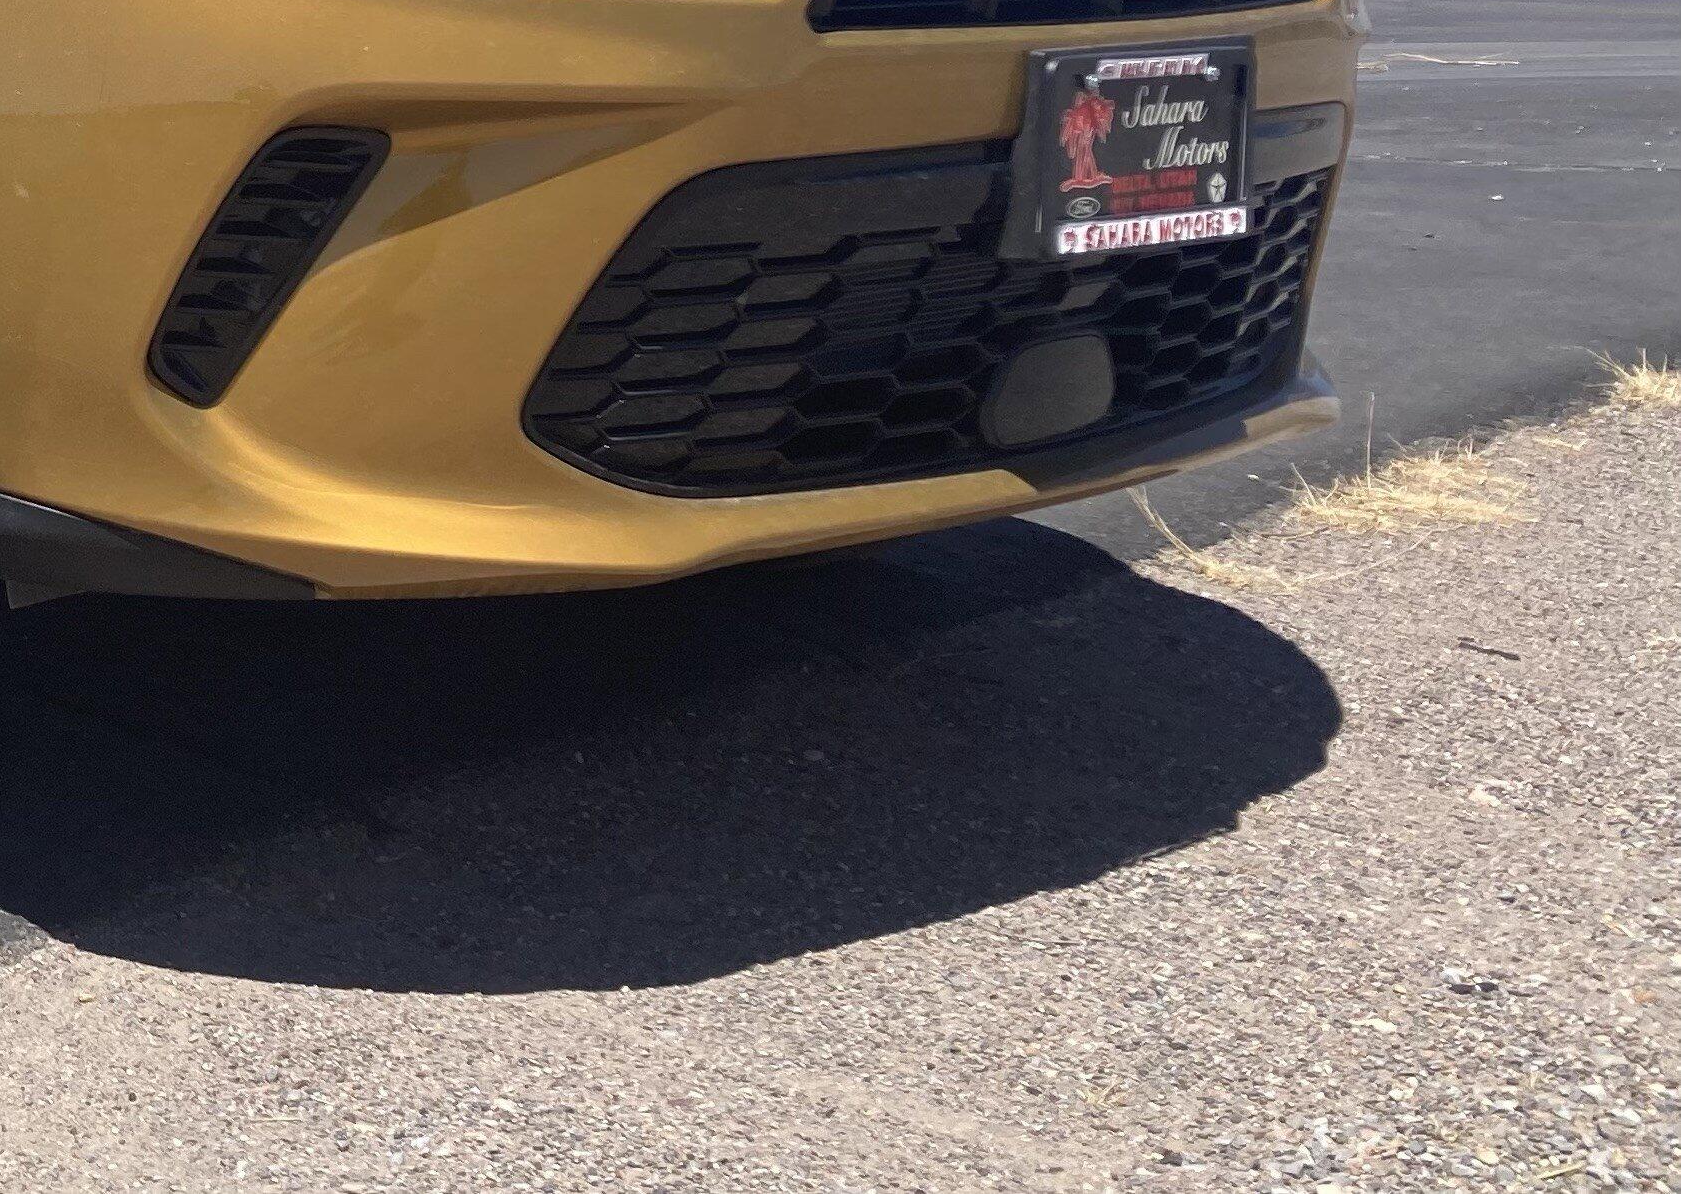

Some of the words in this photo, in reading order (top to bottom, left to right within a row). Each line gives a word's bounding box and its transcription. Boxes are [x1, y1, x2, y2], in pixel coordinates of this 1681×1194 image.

[1120, 85, 1209, 128] Sahara
[1142, 126, 1230, 170] Motors
[1085, 213, 1153, 250] SAHARA
[1159, 210, 1224, 243] MOTORS
